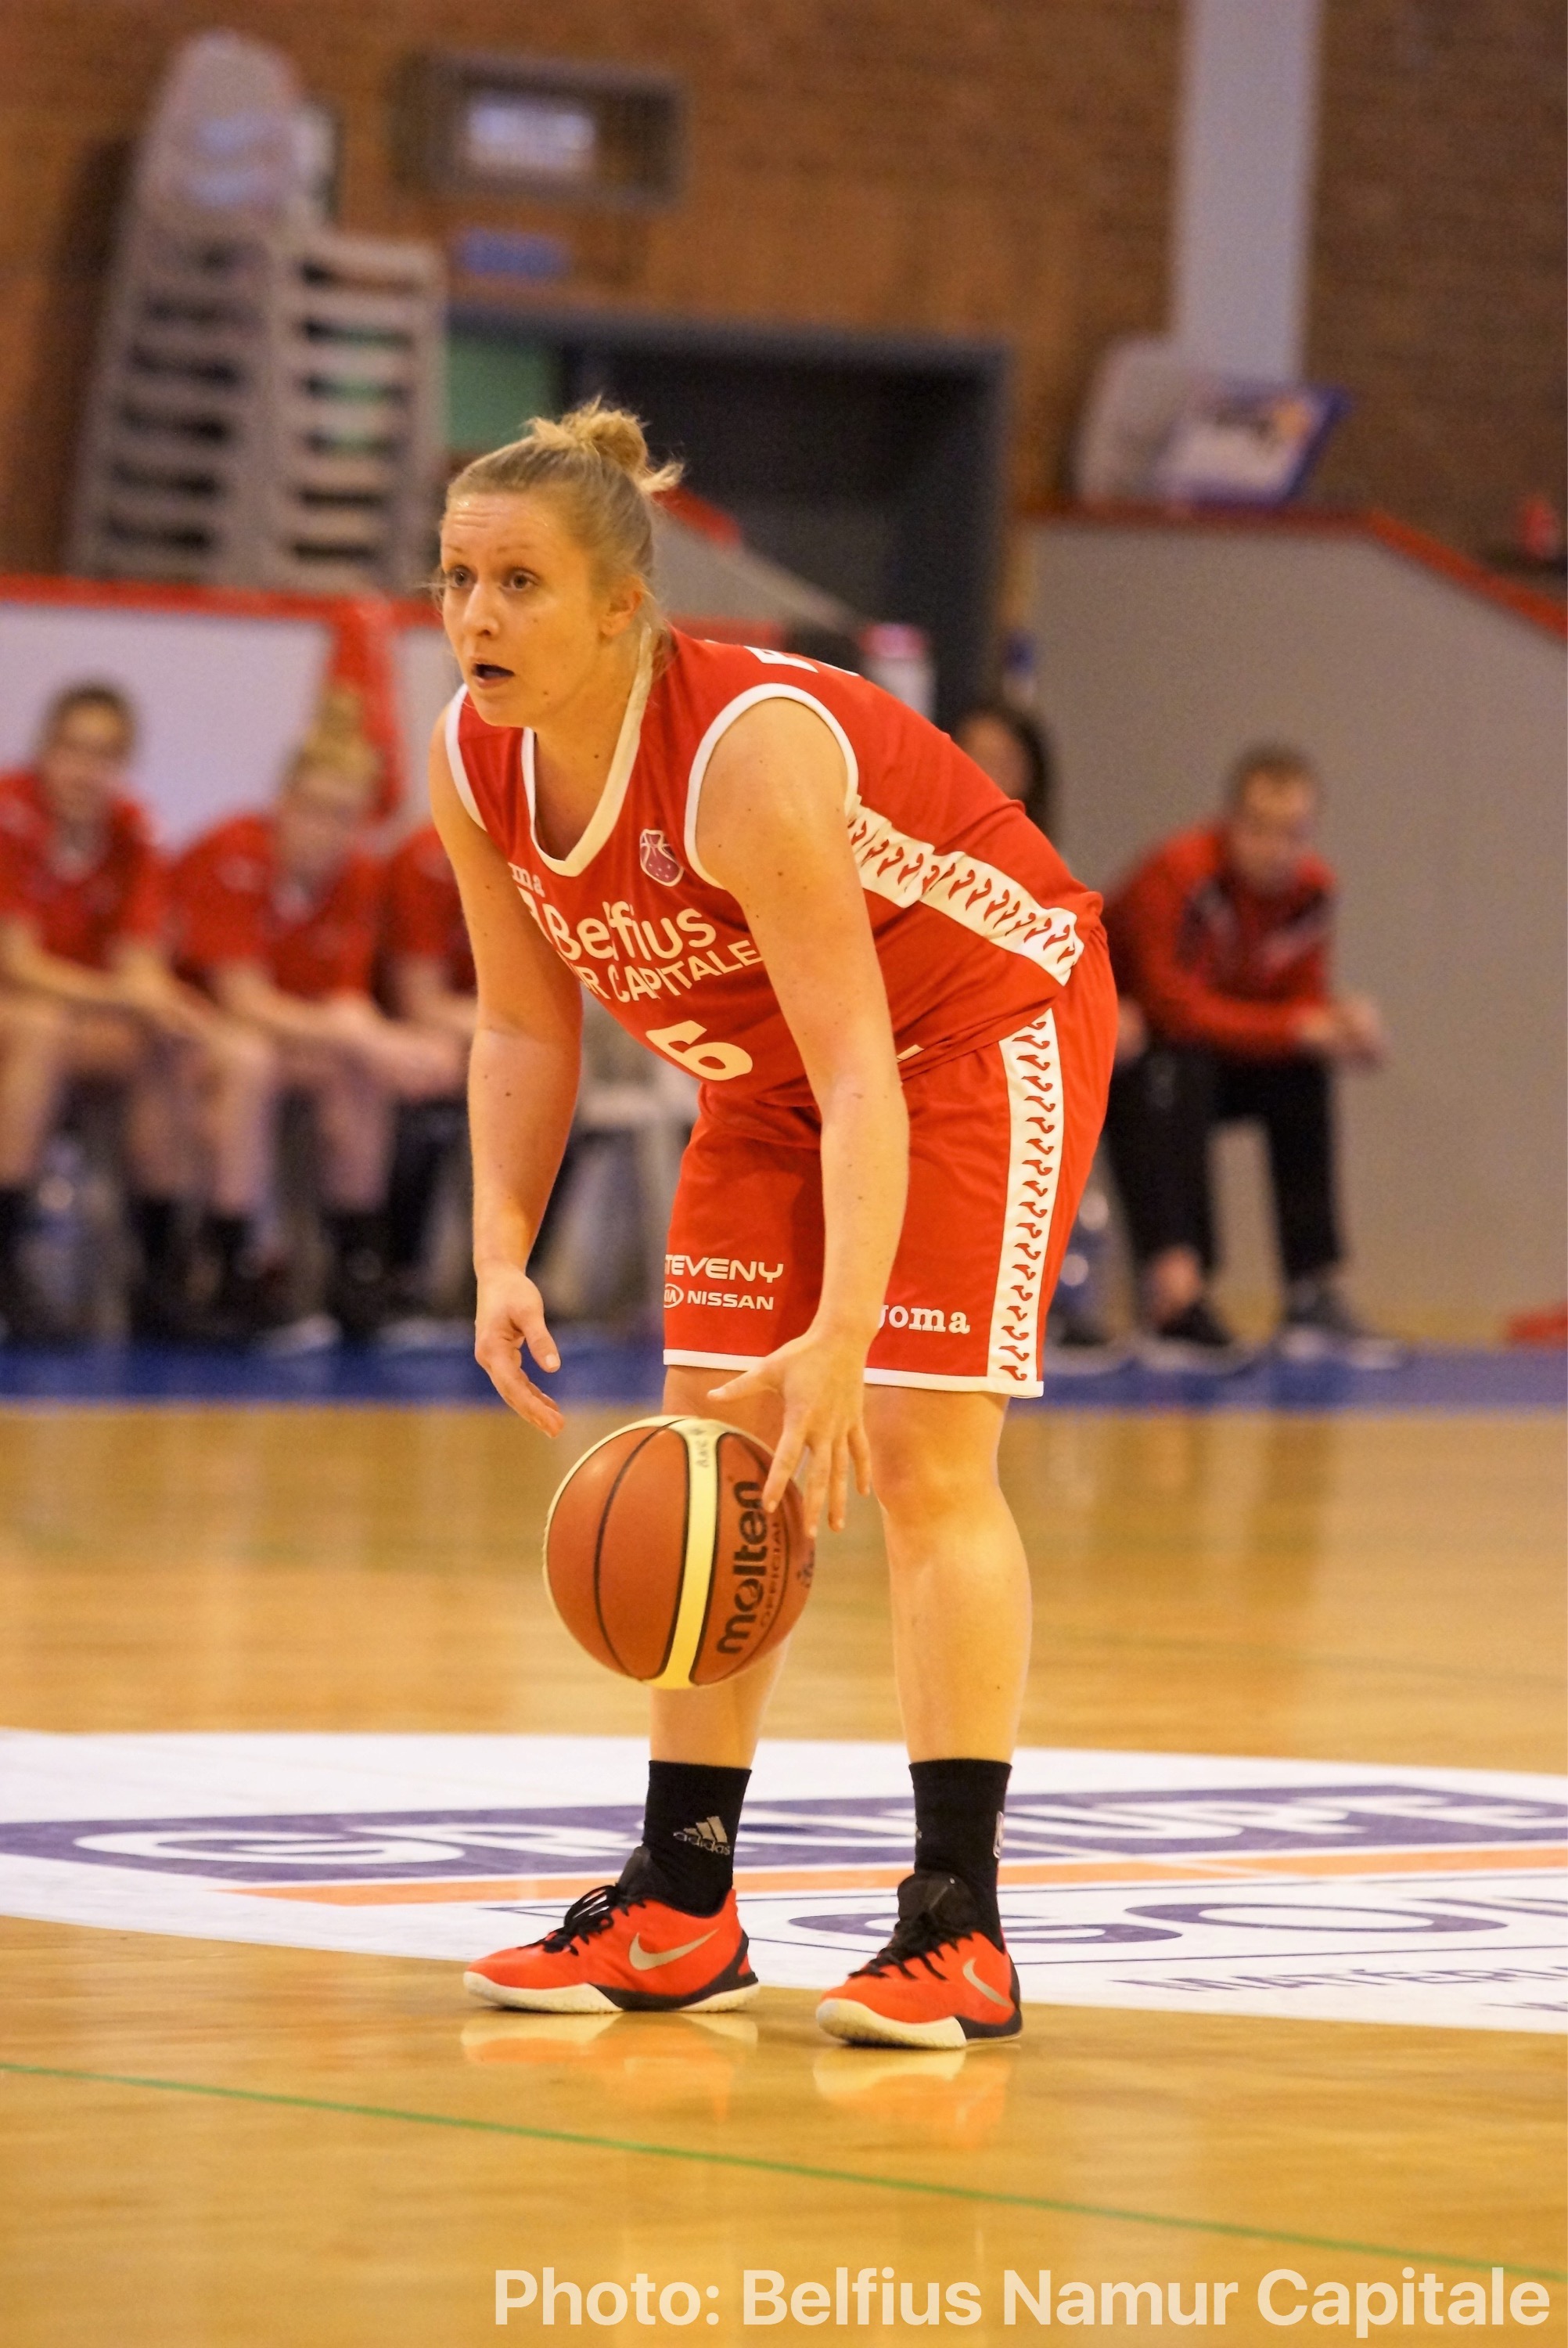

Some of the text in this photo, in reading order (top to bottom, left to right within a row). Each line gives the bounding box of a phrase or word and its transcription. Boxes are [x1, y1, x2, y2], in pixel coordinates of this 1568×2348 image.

[607, 940, 764, 1003] CAPITALE
[646, 1020, 753, 1081] 6
[664, 1254, 784, 1284] TEVENY
[687, 1291, 774, 1310] NISSAN
[717, 1481, 768, 1655] molten
[673, 1831, 731, 1856] adidas
